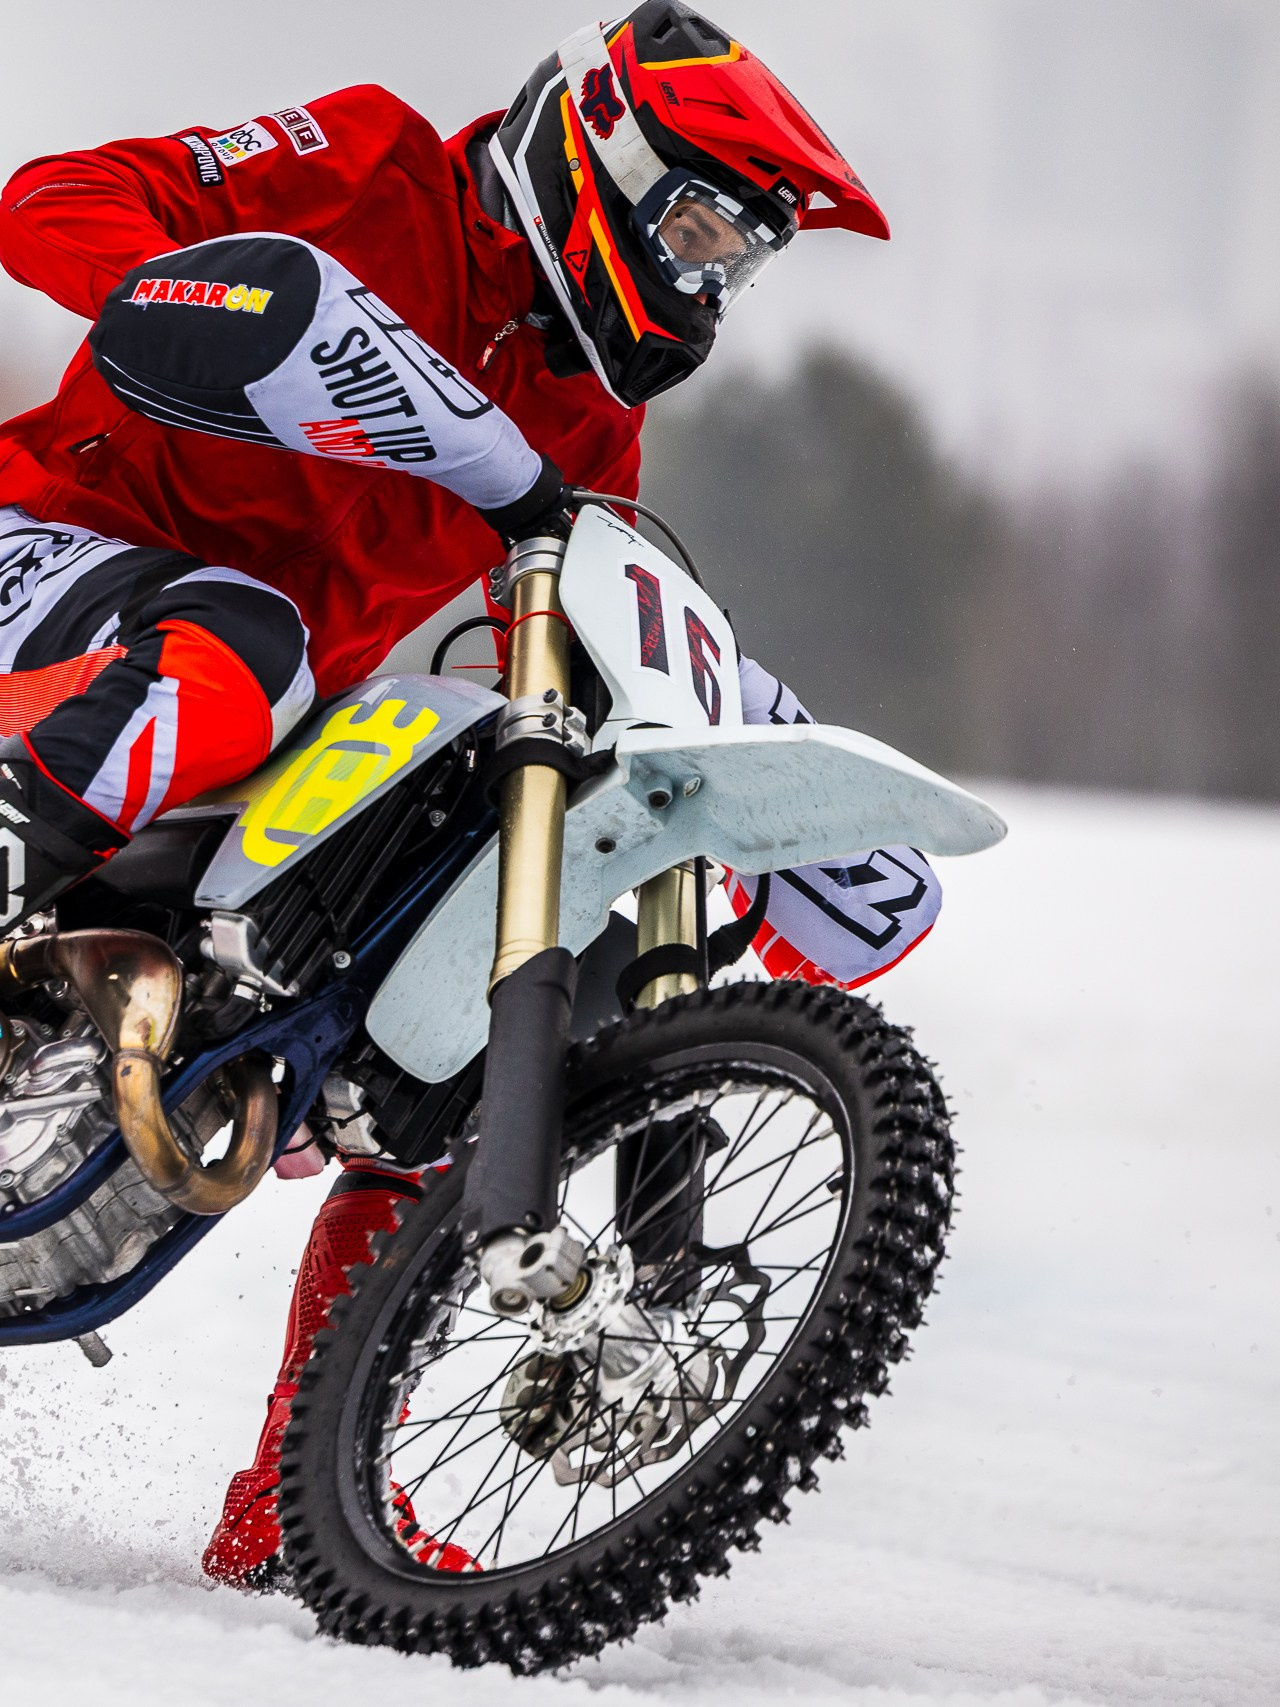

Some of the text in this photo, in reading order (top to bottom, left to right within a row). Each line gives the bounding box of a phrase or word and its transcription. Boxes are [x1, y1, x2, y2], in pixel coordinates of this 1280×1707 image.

[229, 128, 262, 152] ebc
[131, 279, 274, 315] MAKARON
[310, 326, 418, 421] SHUT
[352, 425, 437, 463] UP
